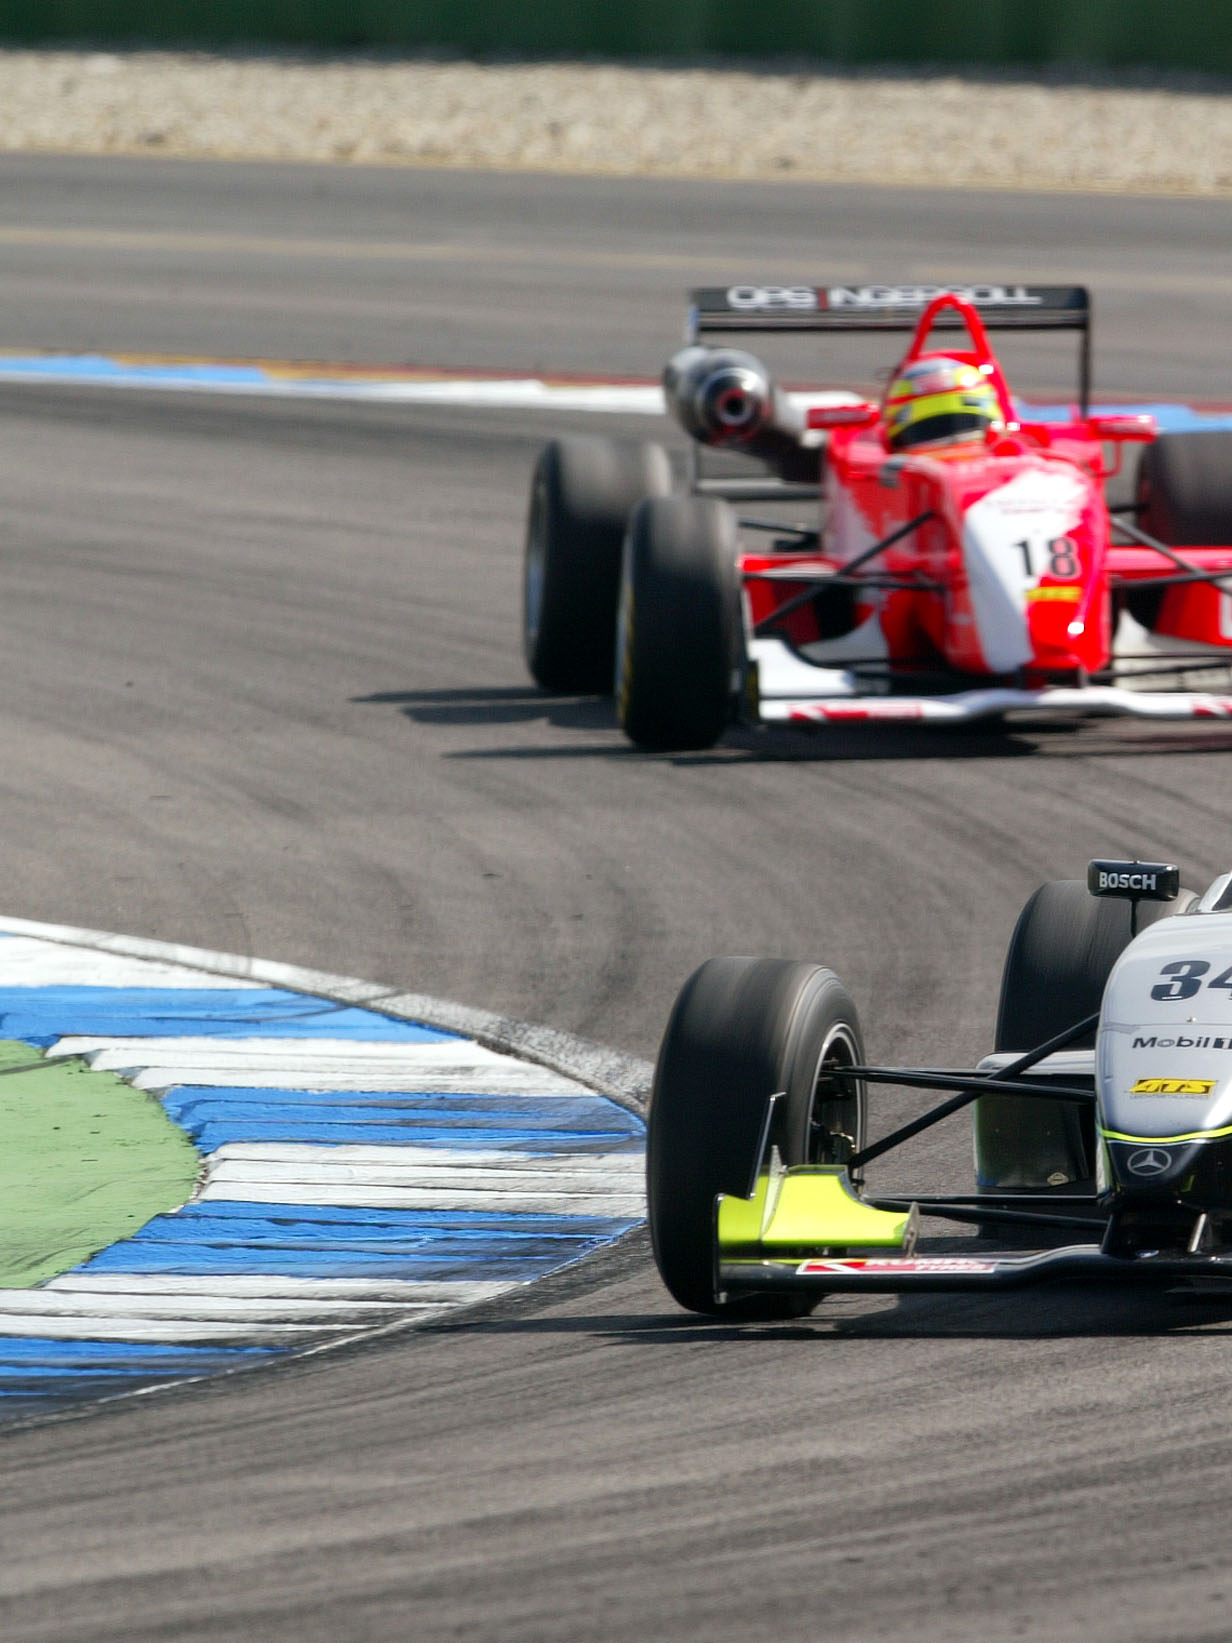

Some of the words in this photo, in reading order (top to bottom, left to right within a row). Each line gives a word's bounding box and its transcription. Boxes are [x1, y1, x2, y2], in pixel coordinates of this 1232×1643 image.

[1011, 538, 1077, 579] 18
[1099, 871, 1157, 890] BOSCH
[1132, 1036, 1211, 1049] Mobil
